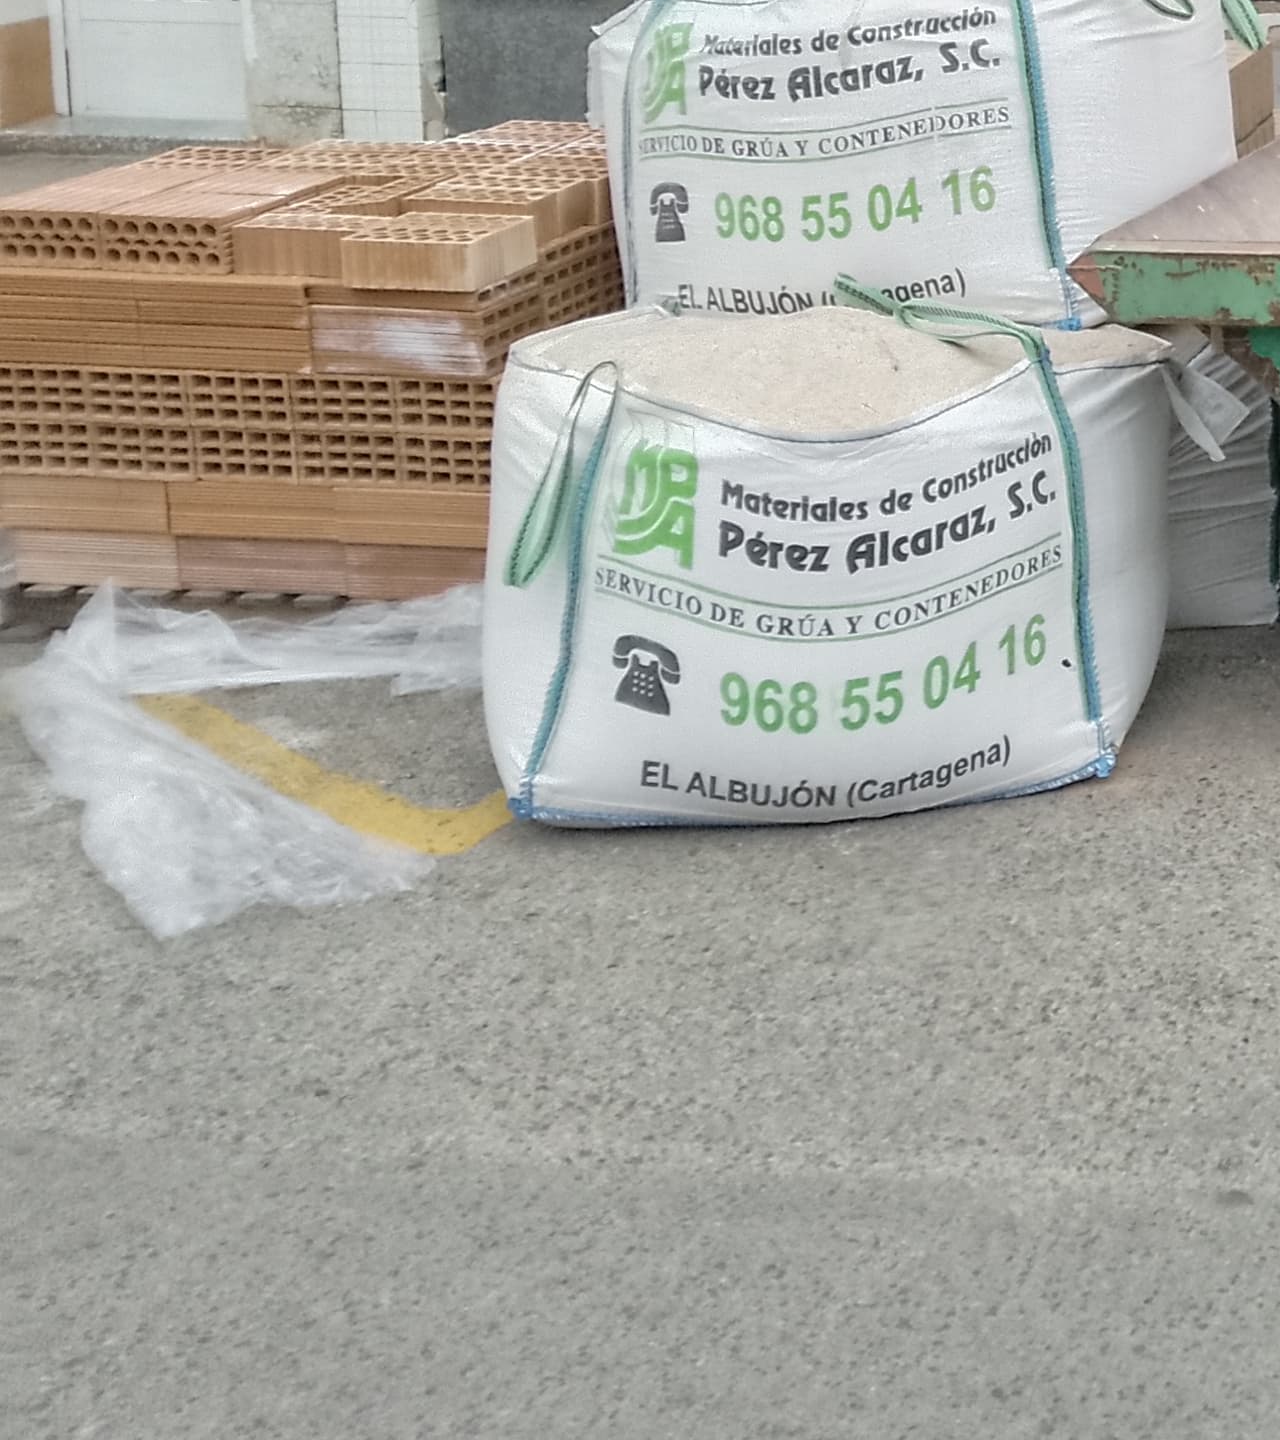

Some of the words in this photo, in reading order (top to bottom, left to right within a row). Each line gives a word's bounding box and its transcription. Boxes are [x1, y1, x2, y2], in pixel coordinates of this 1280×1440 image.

[701, 33, 803, 57] Materiales
[811, 30, 839, 52] de
[847, 7, 997, 46] Construcción
[699, 65, 776, 100] Pérez
[787, 56, 924, 102] Alcaraz,
[939, 38, 1001, 73] S.C.
[702, 137, 725, 154] DE
[732, 137, 789, 157] GRÚA
[795, 139, 809, 156] Y
[818, 106, 1010, 155] CONTENEDORES
[714, 192, 785, 242] 968
[801, 191, 852, 242] 55
[867, 176, 923, 232] 04
[941, 165, 997, 216] 16
[677, 283, 702, 309] EL
[707, 286, 814, 316] ALBUJÓN
[718, 519, 831, 573] Pérez
[845, 505, 996, 575] Alcaraz,
[1006, 470, 1056, 519] S.C.
[721, 478, 869, 523] Materiales
[879, 488, 913, 515] de
[595, 567, 702, 616] SERVICIO
[710, 601, 745, 629] DE
[756, 614, 835, 637] GRÚA
[846, 615, 863, 635] Y
[874, 544, 1062, 631] CONTENEDORES
[720, 671, 818, 735] 968
[840, 670, 903, 731] 55
[923, 640, 981, 710] 04
[998, 613, 1047, 676] 16
[640, 760, 679, 792] EL
[685, 771, 836, 808] ALBUJÓN
[846, 734, 1012, 808] (Cartagena)
